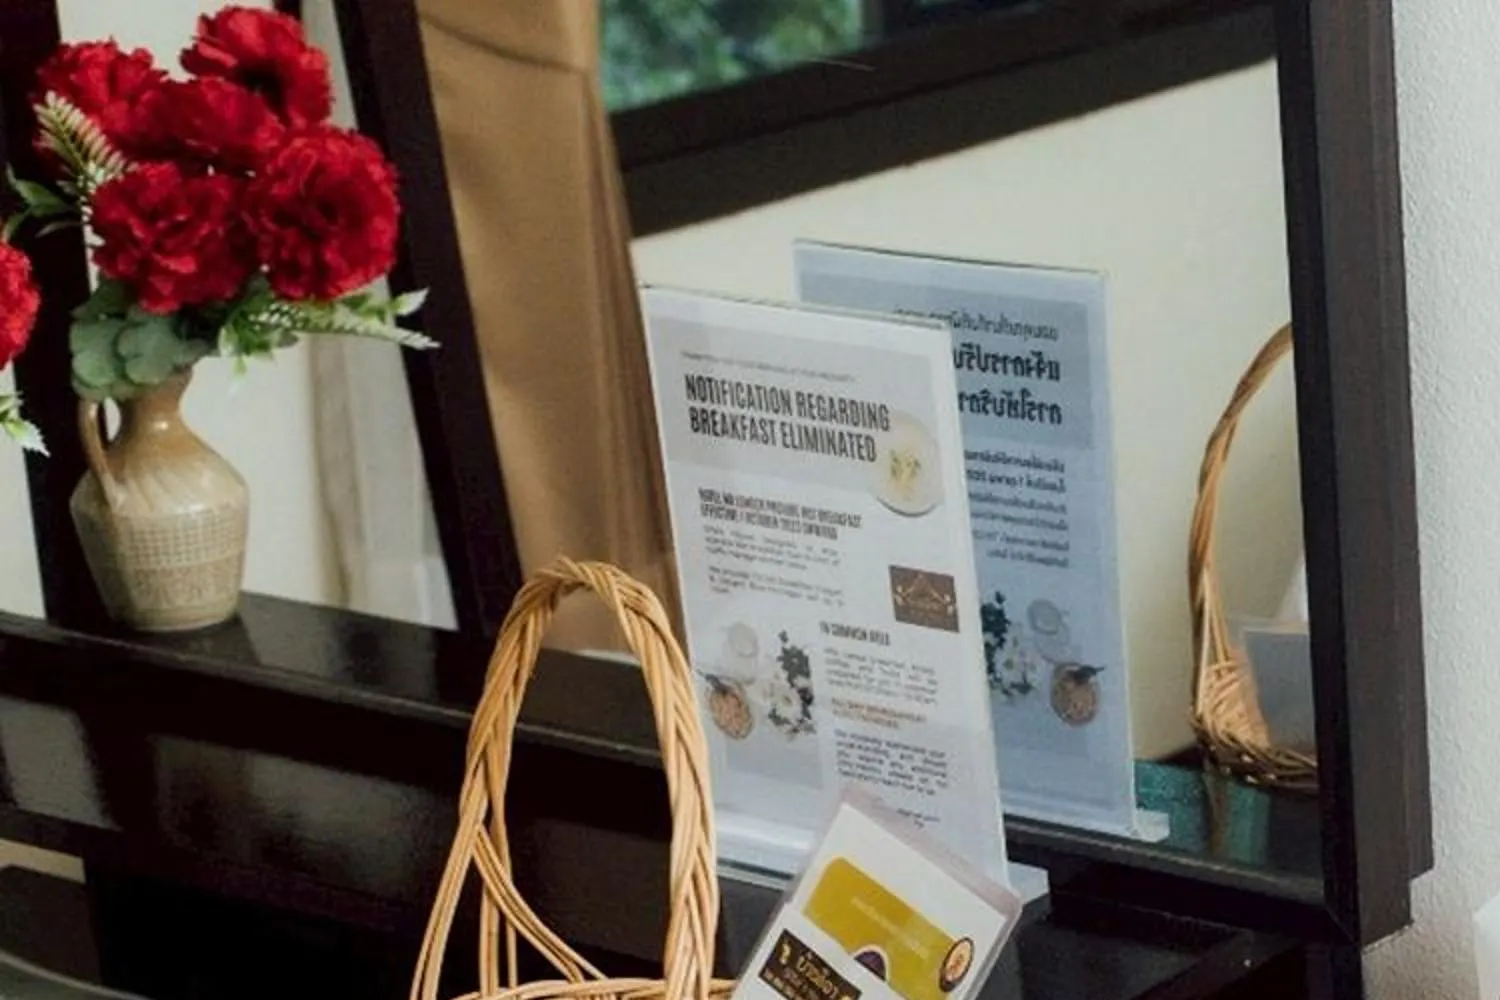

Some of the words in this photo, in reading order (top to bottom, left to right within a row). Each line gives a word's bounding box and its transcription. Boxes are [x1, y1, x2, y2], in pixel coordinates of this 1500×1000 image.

[684, 374, 793, 416] NOTIFICATION
[796, 391, 890, 432] REGARDING
[688, 406, 777, 446] BREAKFAST
[780, 421, 878, 463] ELIMINATED
